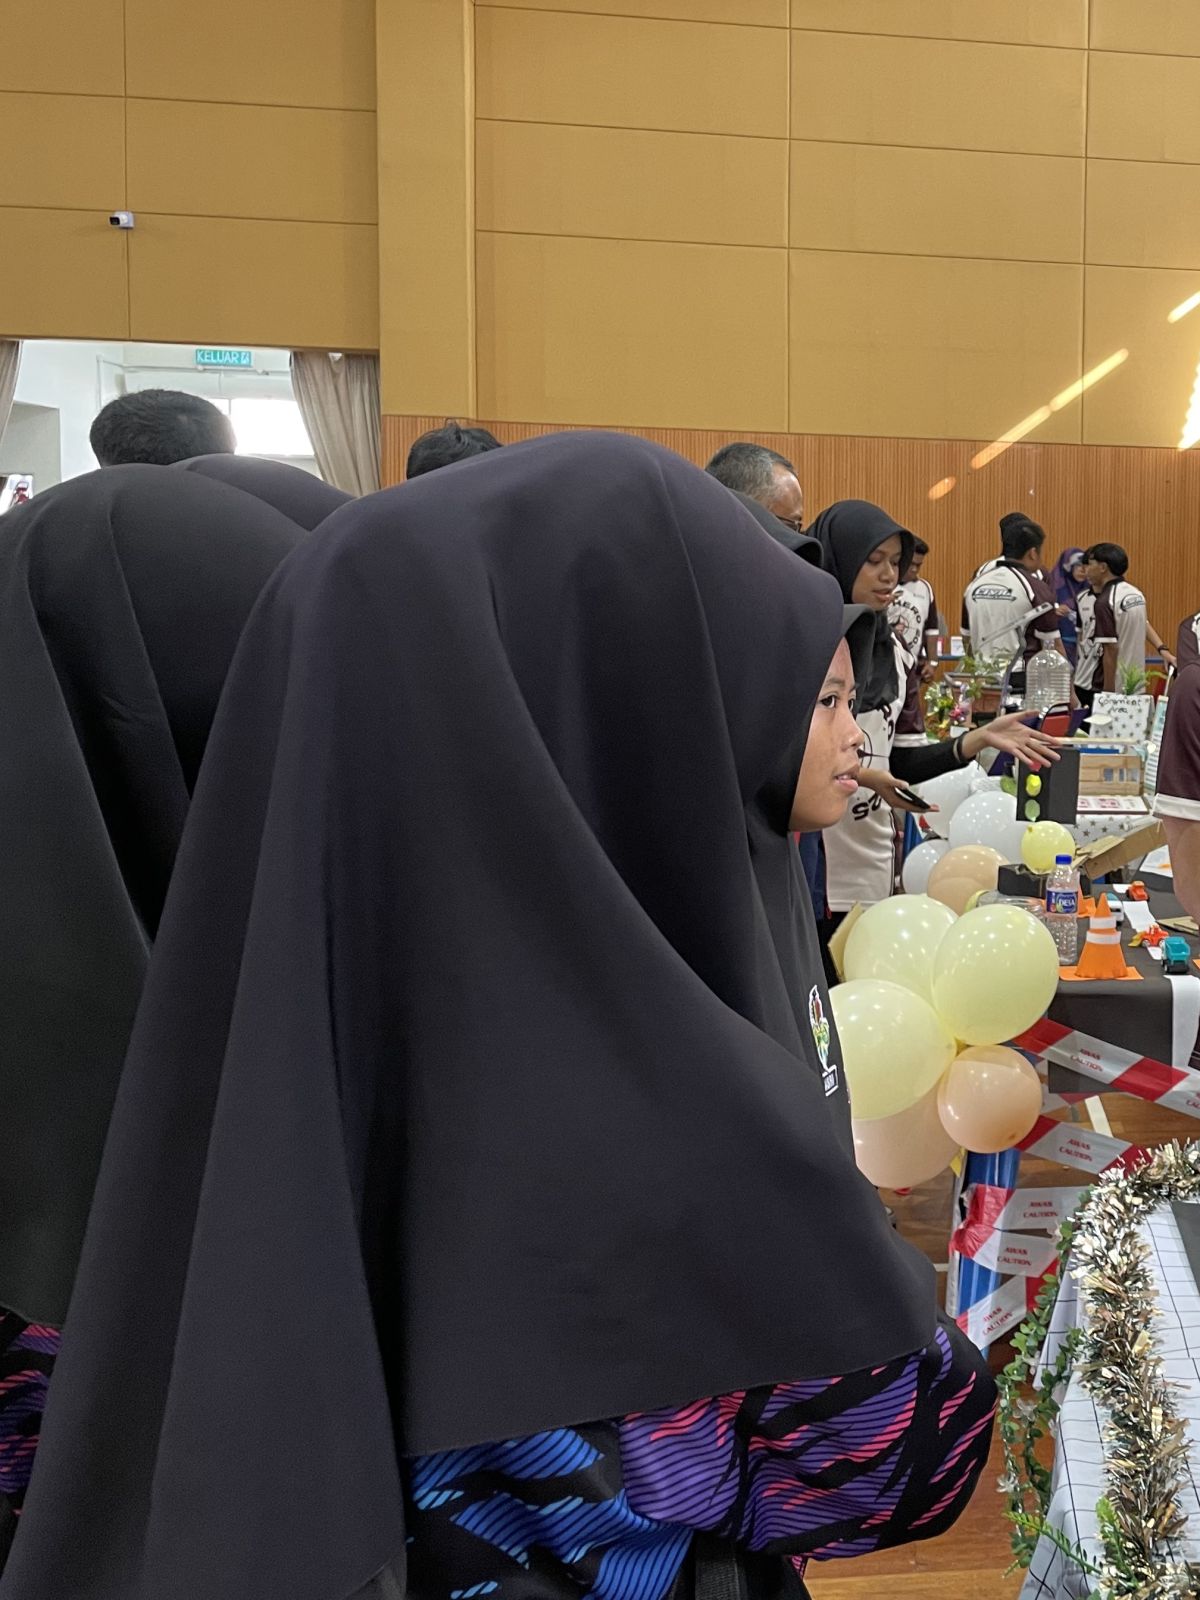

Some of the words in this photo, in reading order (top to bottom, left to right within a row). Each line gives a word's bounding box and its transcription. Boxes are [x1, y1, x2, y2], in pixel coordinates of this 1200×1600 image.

[197, 350, 239, 364] KELUAR
[1070, 1055, 1104, 1073] CAUTION
[1059, 1146, 1093, 1162] CAUTION
[1023, 1210, 1059, 1218] CAUTION
[996, 1256, 1032, 1267] CAUTION
[982, 1311, 1013, 1336] CAUTION
